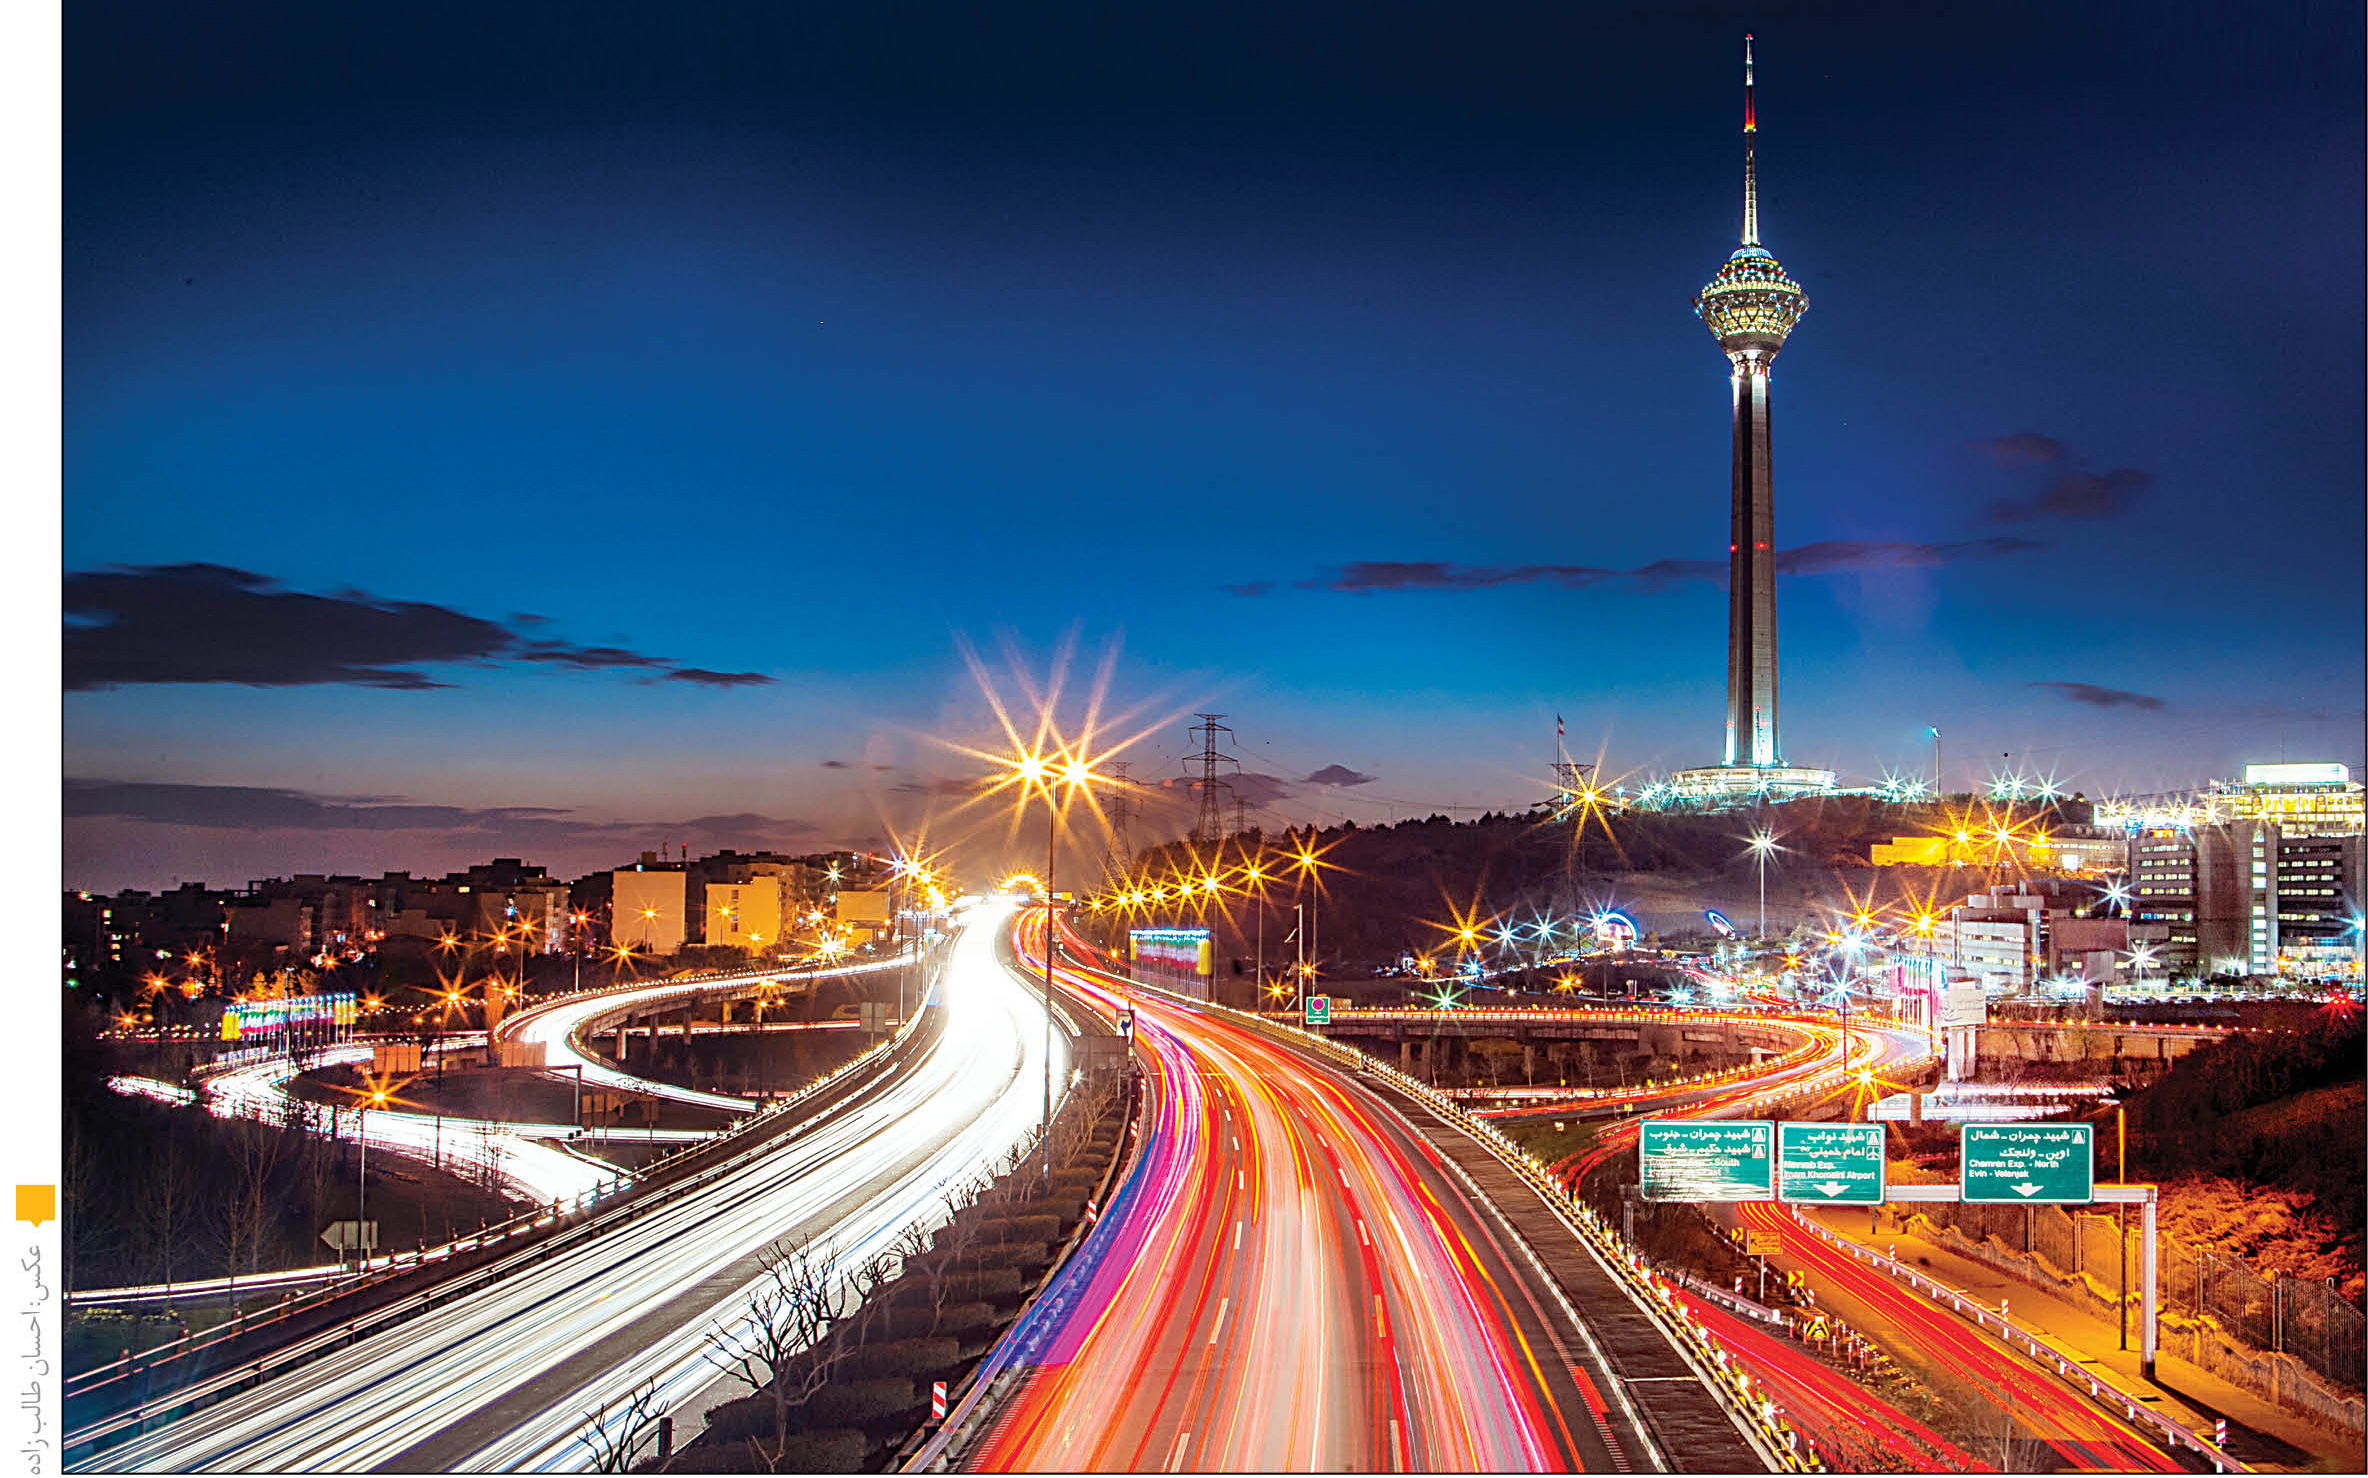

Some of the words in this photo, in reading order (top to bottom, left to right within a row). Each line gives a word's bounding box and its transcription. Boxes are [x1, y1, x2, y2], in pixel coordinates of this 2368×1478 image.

[1649, 1130, 1681, 1142] جنوب
[1689, 1129, 1723, 1142] چمران
[1724, 1129, 1751, 1141] شهید
[1807, 1131, 1837, 1145] نواب
[1838, 1131, 1866, 1144] شهید
[1970, 1130, 2000, 1141] شمال
[2008, 1130, 2041, 1144] چمران
[2043, 1130, 2070, 1142] شهید
[1696, 1144, 1722, 1155] حکیم
[1724, 1144, 1751, 1156] شهید
[1842, 1147, 1866, 1160] امام
[1999, 1148, 2037, 1159] ولنجک
[2045, 1148, 2070, 1160] اوین
[1715, 1158, 1741, 1167] South
[1969, 1159, 2006, 1168] Chamran
[2034, 1160, 2060, 1168] North
[1847, 1171, 1876, 1180] Airport
[1969, 1170, 1988, 1178] Evin
